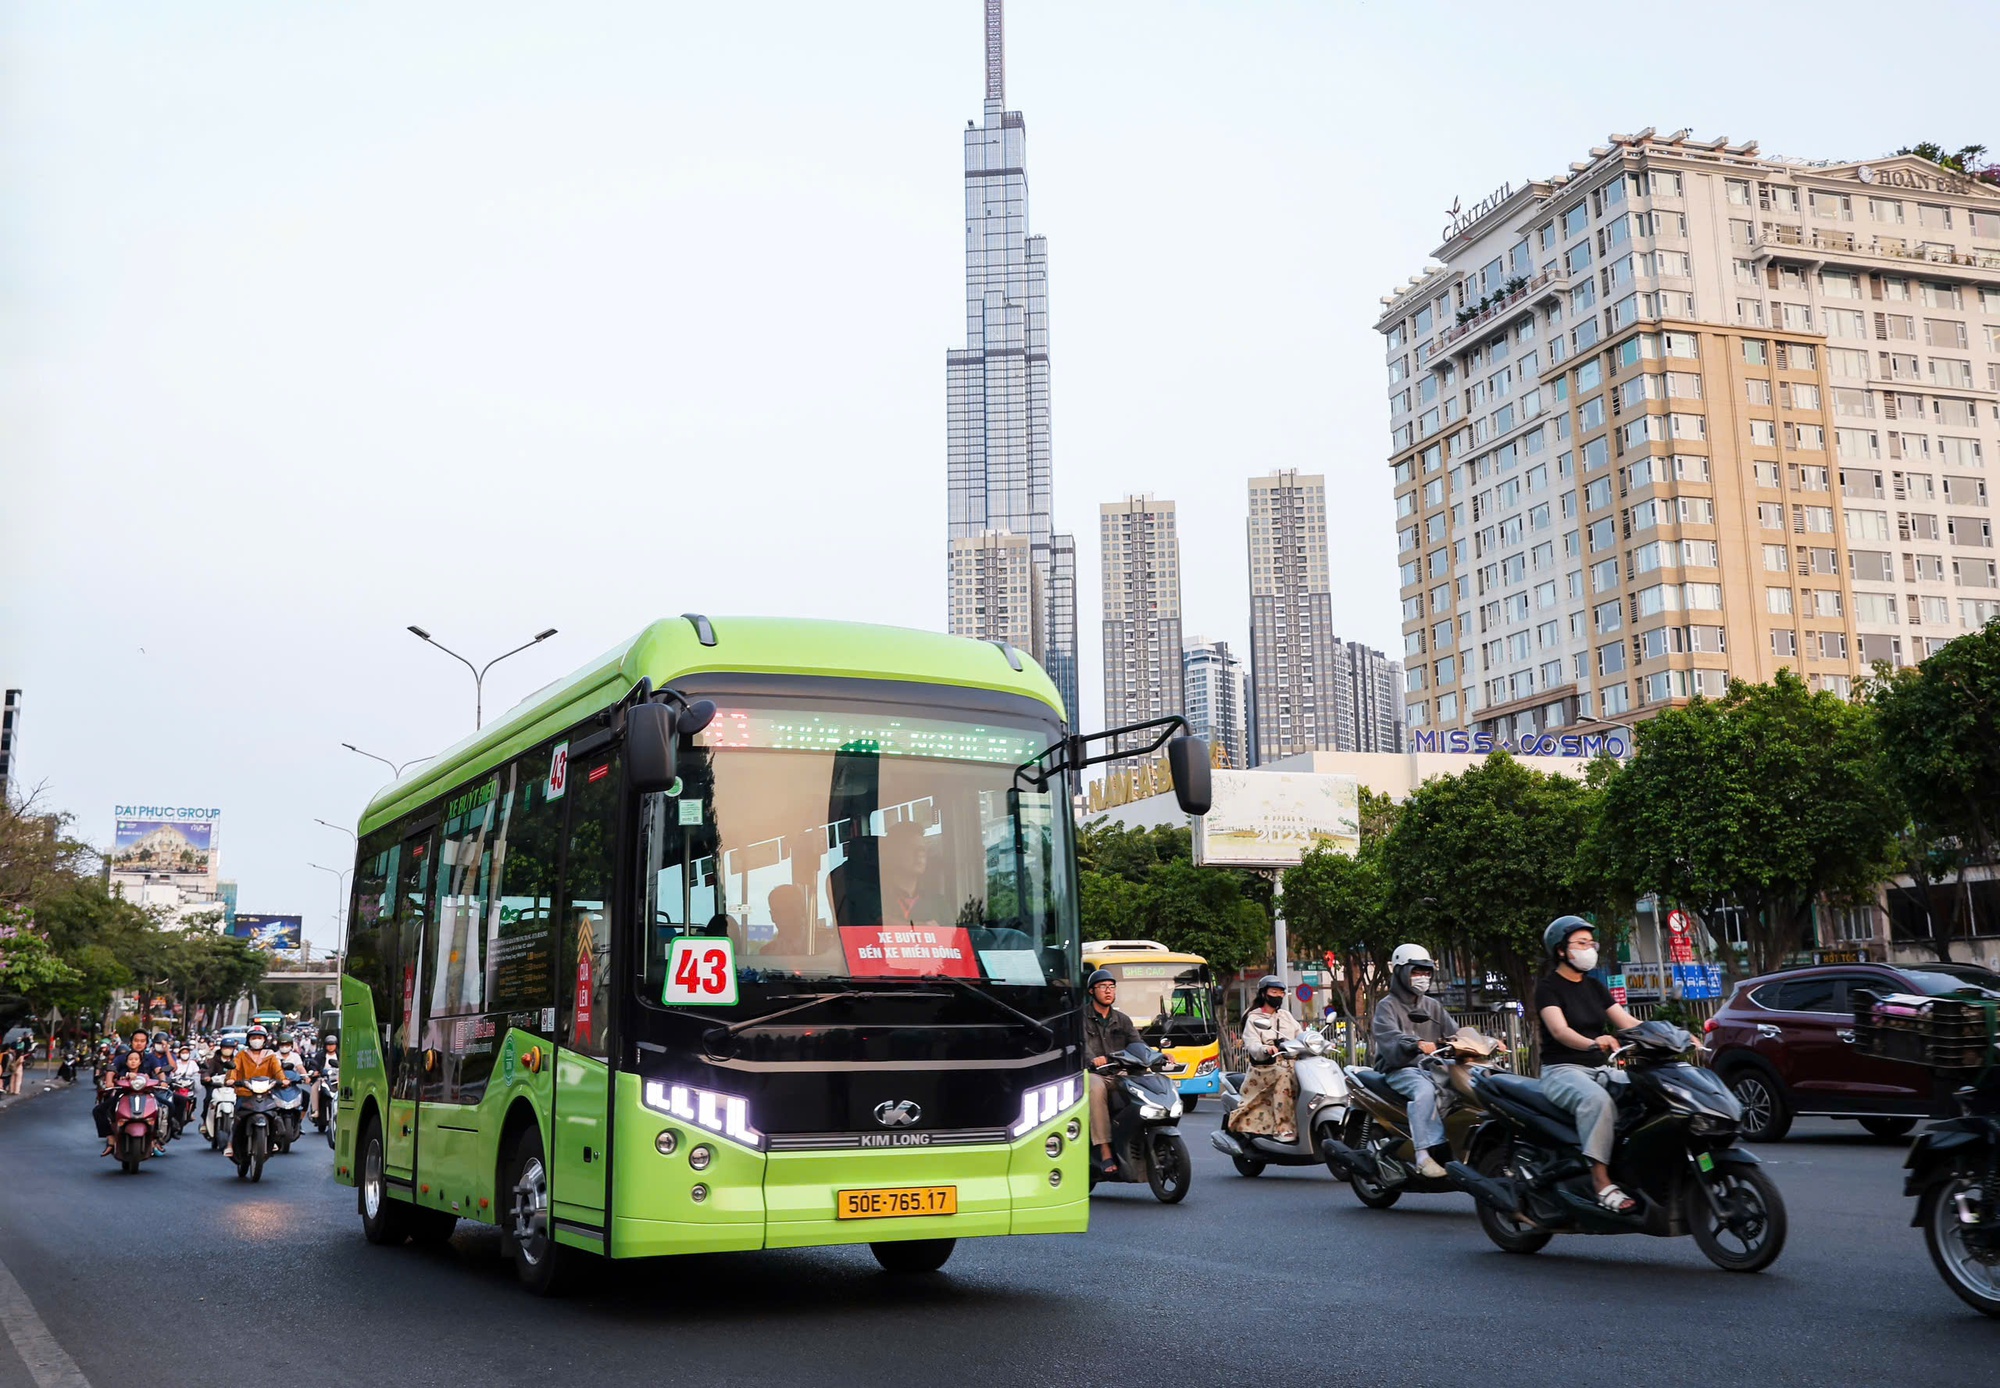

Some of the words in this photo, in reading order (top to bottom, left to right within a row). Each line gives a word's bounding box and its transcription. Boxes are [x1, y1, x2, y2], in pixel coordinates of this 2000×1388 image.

[1442, 180, 1514, 243] CANTAVIL
[1415, 729, 1494, 754] MISS
[1520, 732, 1625, 759] COSMO
[550, 750, 568, 792] 43
[1089, 768, 1134, 814] NAM
[115, 805, 137, 816] DAI
[139, 806, 176, 817] PHUC
[176, 807, 221, 819] GROUP
[449, 798, 459, 819] XE
[1256, 828, 1311, 845] 2023
[877, 932, 893, 944] XE
[884, 947, 900, 959] XE
[675, 948, 727, 995] 43
[861, 1134, 890, 1147] KIM
[892, 1133, 930, 1146] LONG
